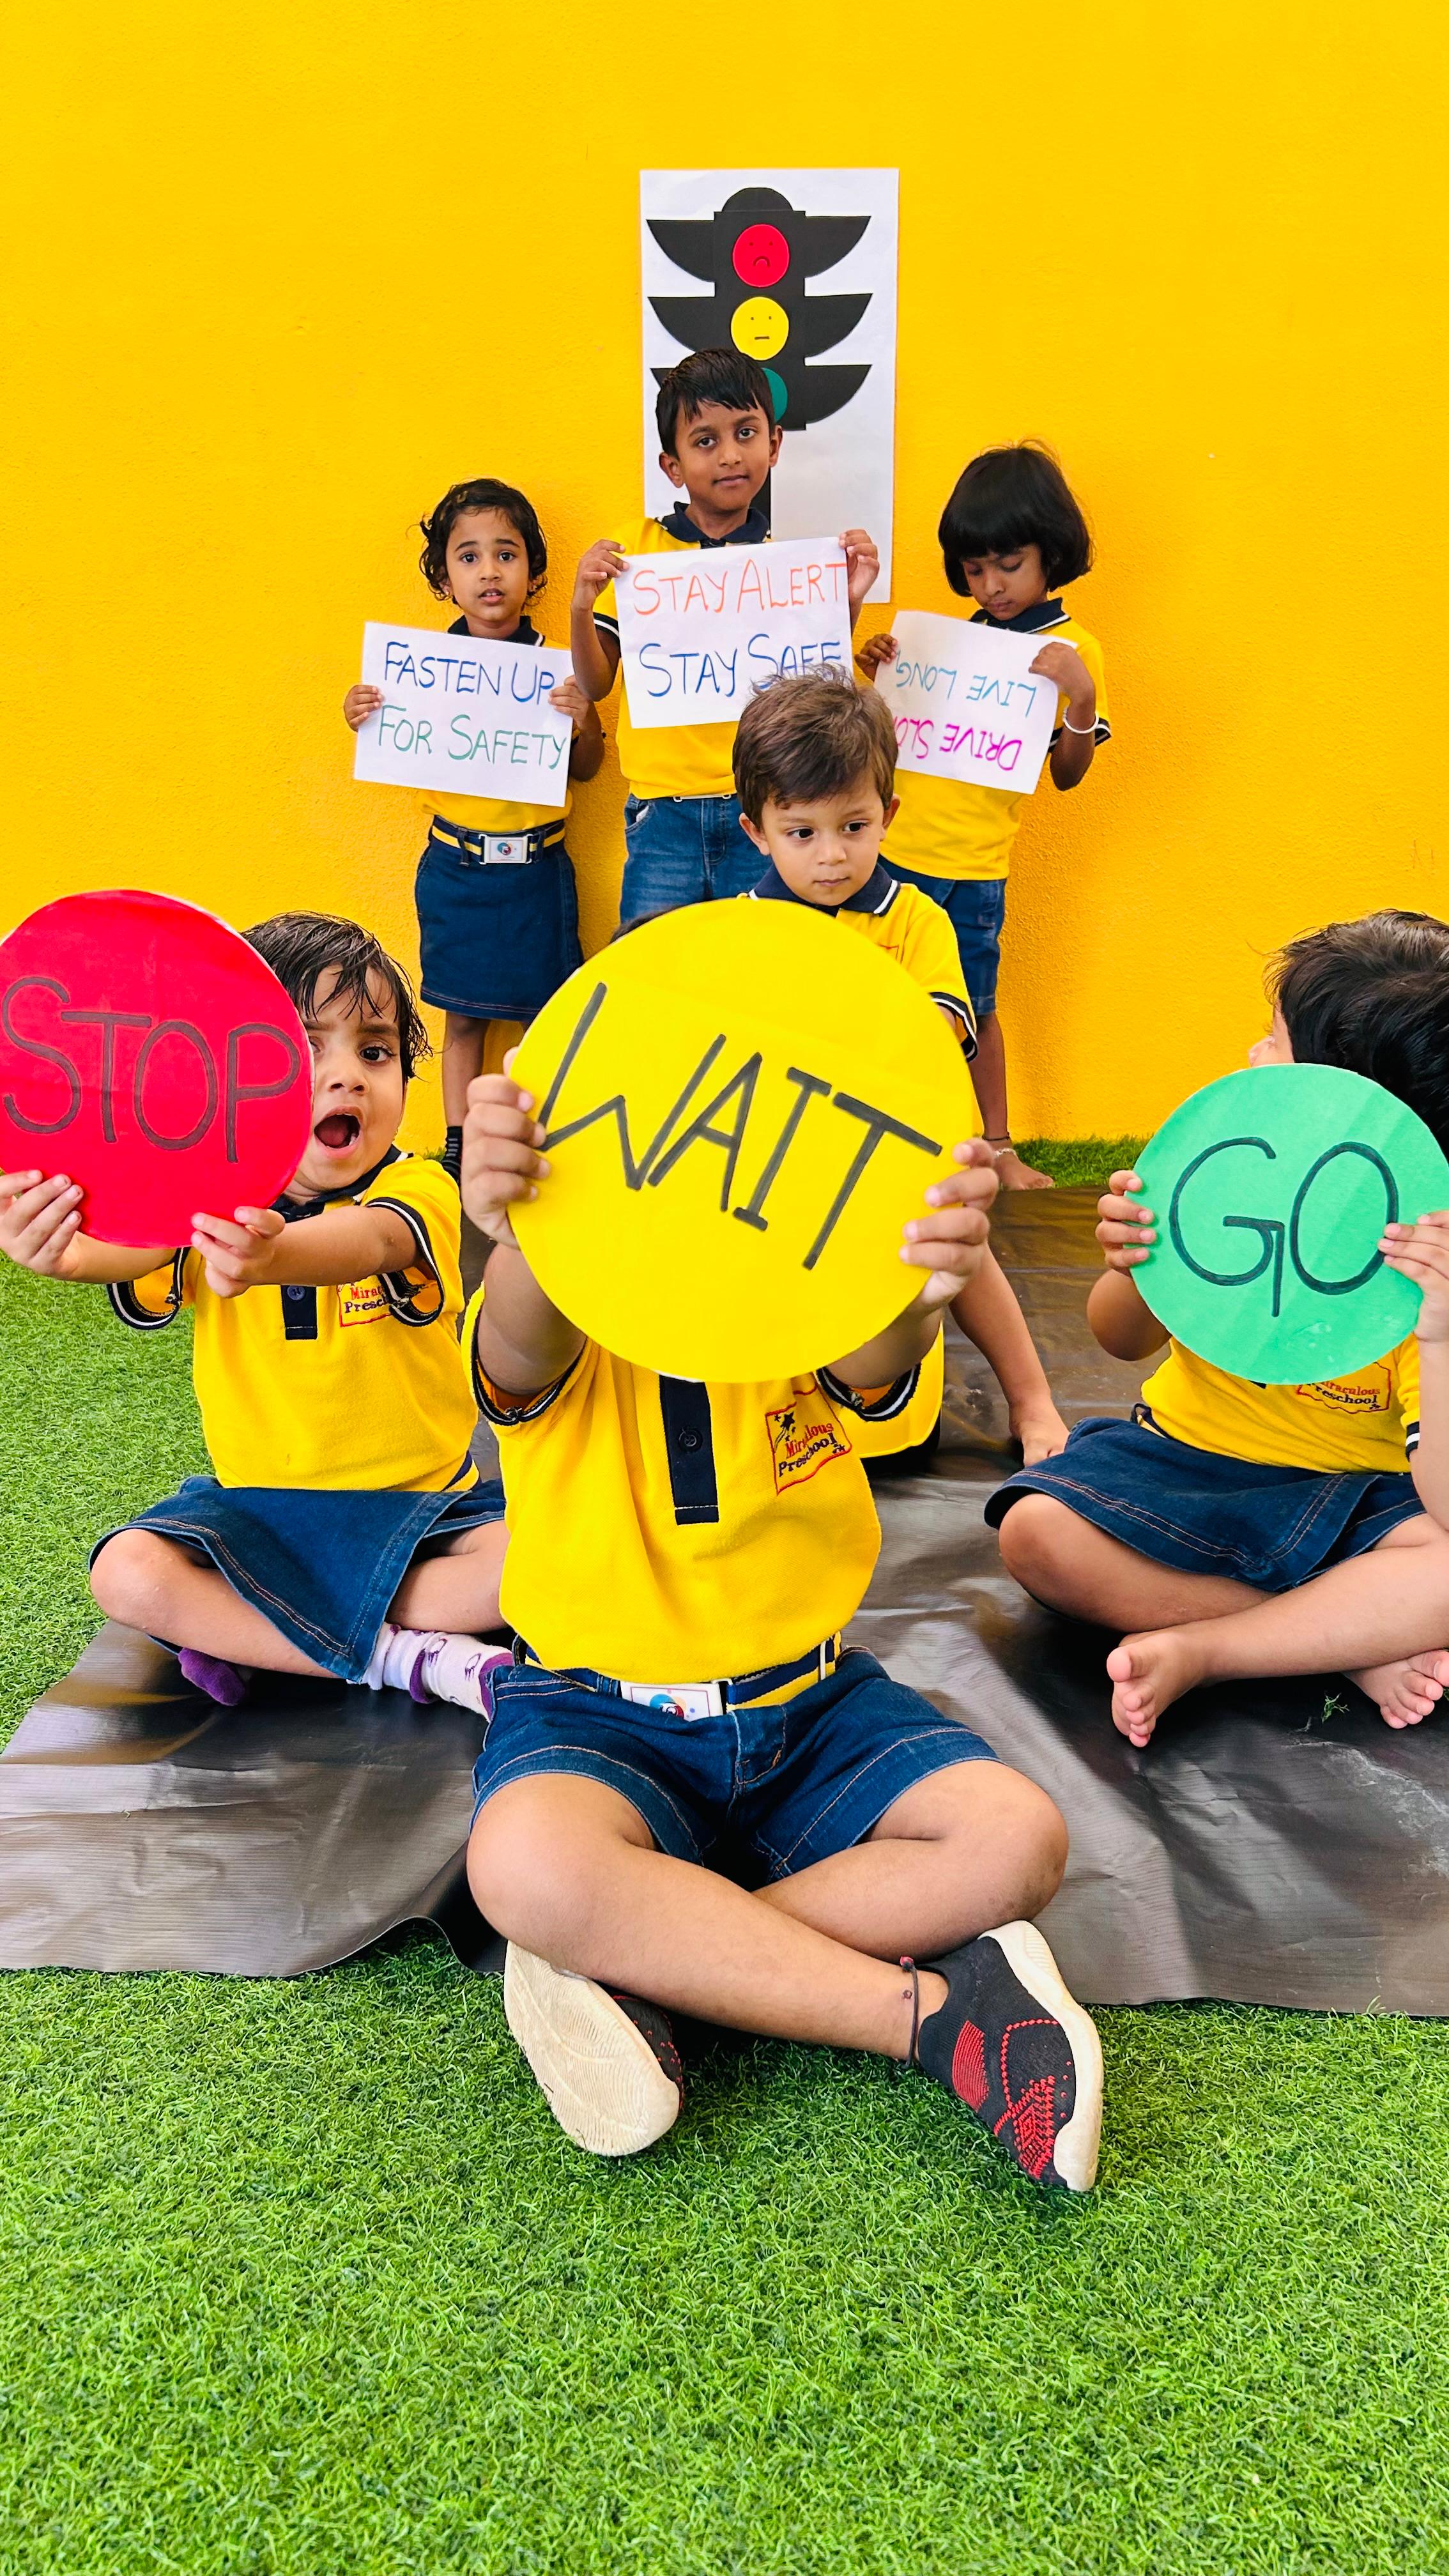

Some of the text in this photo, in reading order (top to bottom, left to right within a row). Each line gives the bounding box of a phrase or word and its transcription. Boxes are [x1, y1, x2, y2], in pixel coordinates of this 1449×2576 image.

[632, 558, 847, 616] STAY ALERT
[385, 641, 555, 705] FASTEN UP
[639, 643, 737, 698] STAY
[896, 650, 1037, 717] LIVE LONG
[378, 705, 567, 770] FOR SAFETY
[893, 716, 1022, 771] DRIVE SLO
[2, 976, 300, 1163] STOP
[537, 982, 942, 1271] WAIT
[1169, 1137, 1399, 1317] GO
[344, 1299, 384, 1314] Presc
[1313, 1384, 1377, 1404] reschool
